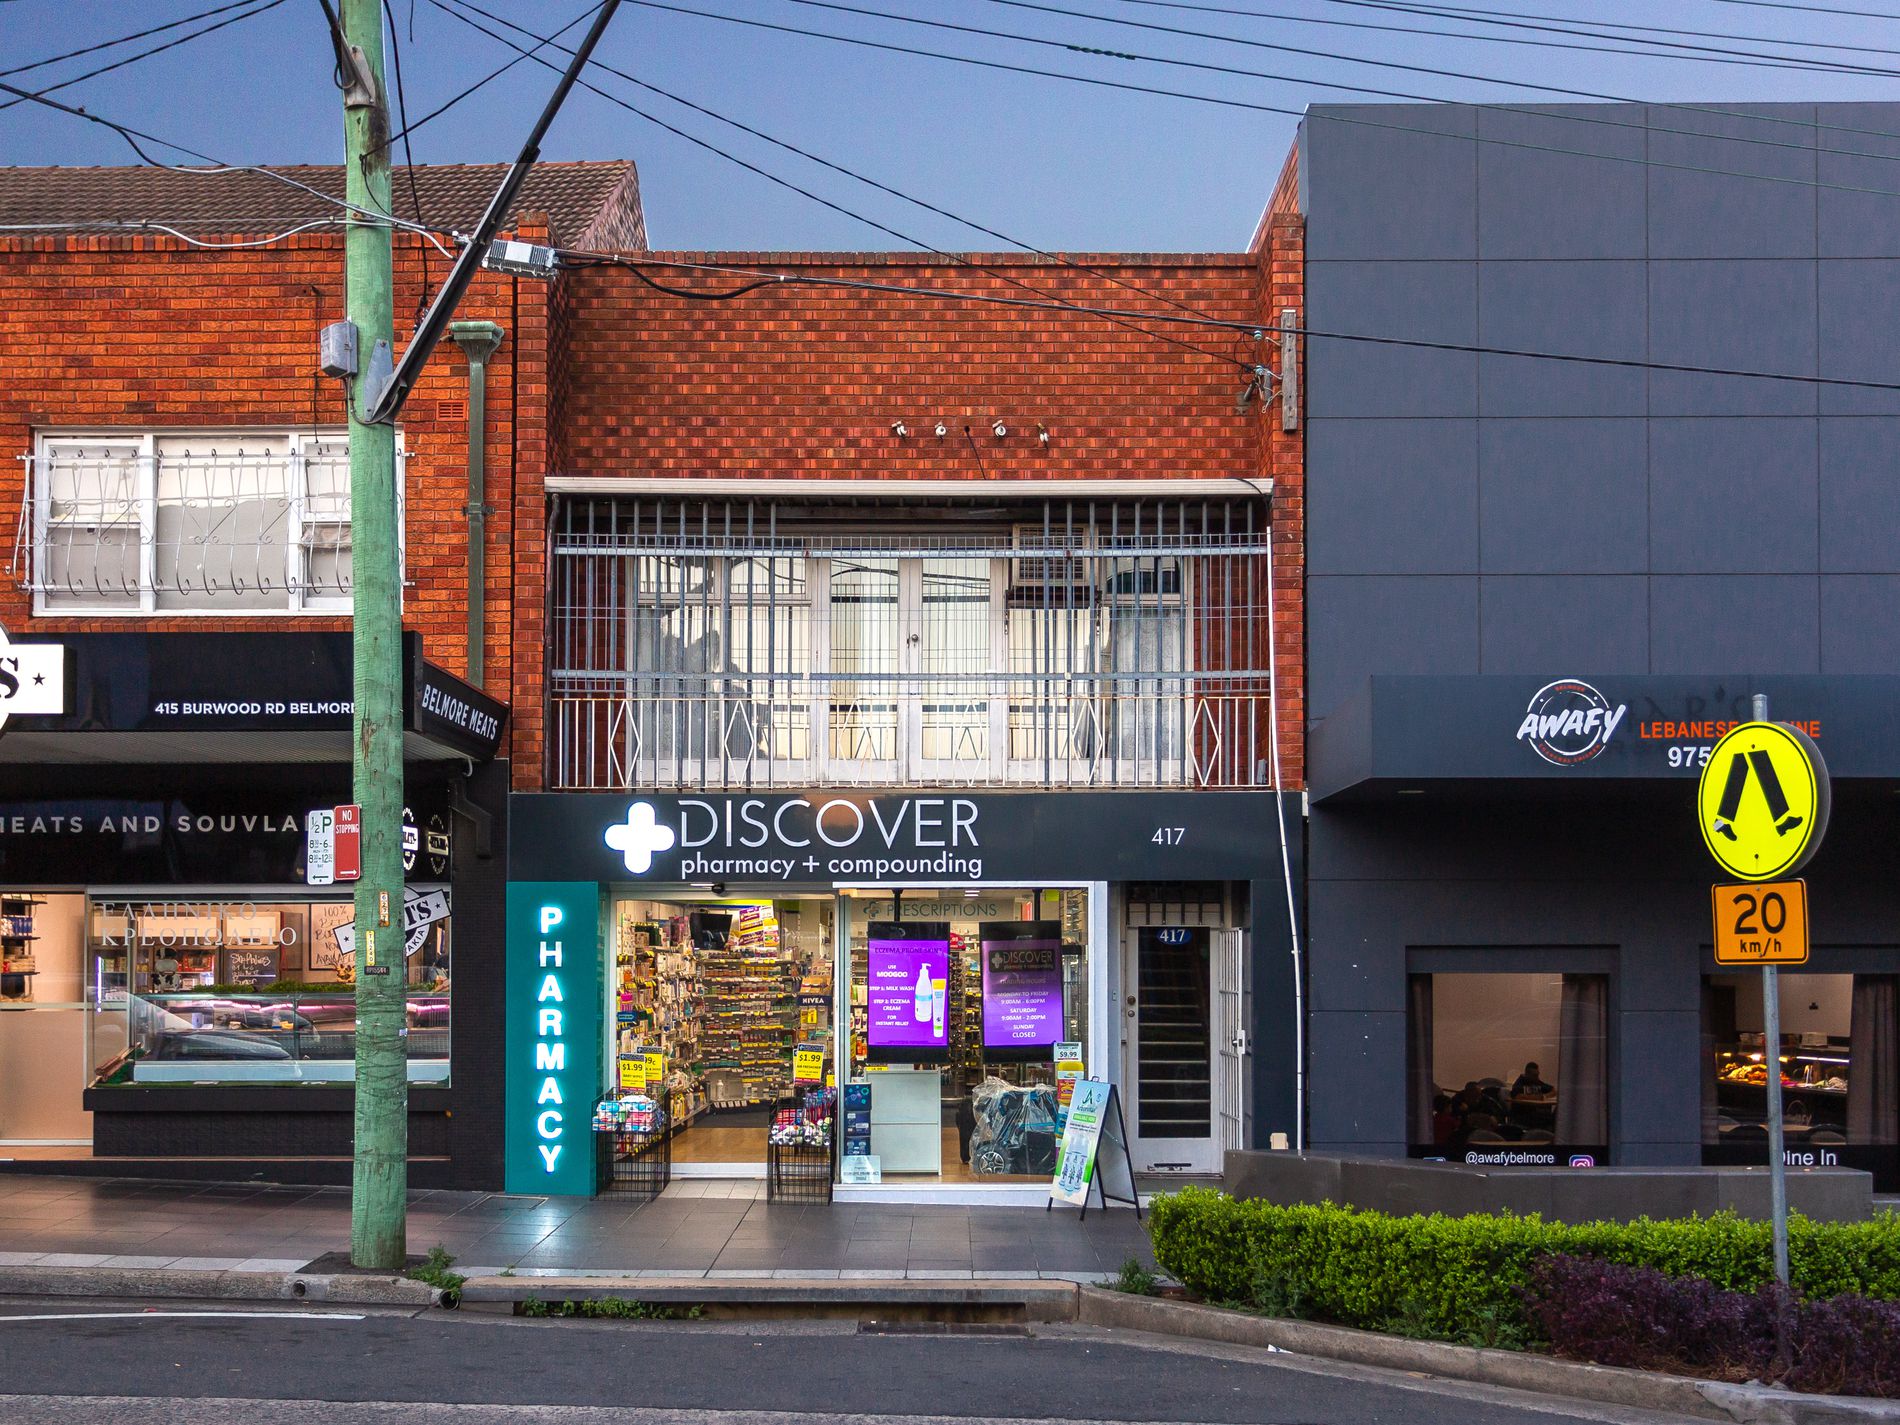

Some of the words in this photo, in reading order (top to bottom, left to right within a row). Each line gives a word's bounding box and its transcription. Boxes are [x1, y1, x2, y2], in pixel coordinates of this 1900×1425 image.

[155, 703, 179, 714] 415
[183, 703, 261, 714] BURWOOD
[265, 703, 285, 714] RD
[422, 684, 469, 727] BELMORE
[469, 708, 498, 740] MEATS
[1516, 704, 1626, 743] AWAFY
[100, 816, 160, 833] AND
[177, 815, 309, 832] SOUVLA
[342, 809, 352, 821] NO
[678, 799, 979, 849] DISCOVER
[335, 823, 359, 834] STOPPING
[1152, 827, 1185, 845] 417
[681, 851, 795, 879] pharmacy
[802, 856, 819, 873] +
[828, 851, 982, 879] compounding
[1732, 892, 1786, 934] 20
[1159, 928, 1186, 942] 417
[1740, 938, 1781, 956] km/h
[1003, 951, 1053, 963] DISCOVER
[536, 906, 565, 1172] PHARMACY
[799, 1054, 821, 1062] $1.99
[1465, 1151, 1554, 1166] @awafybelmore
[1821, 1149, 1837, 1165] In
